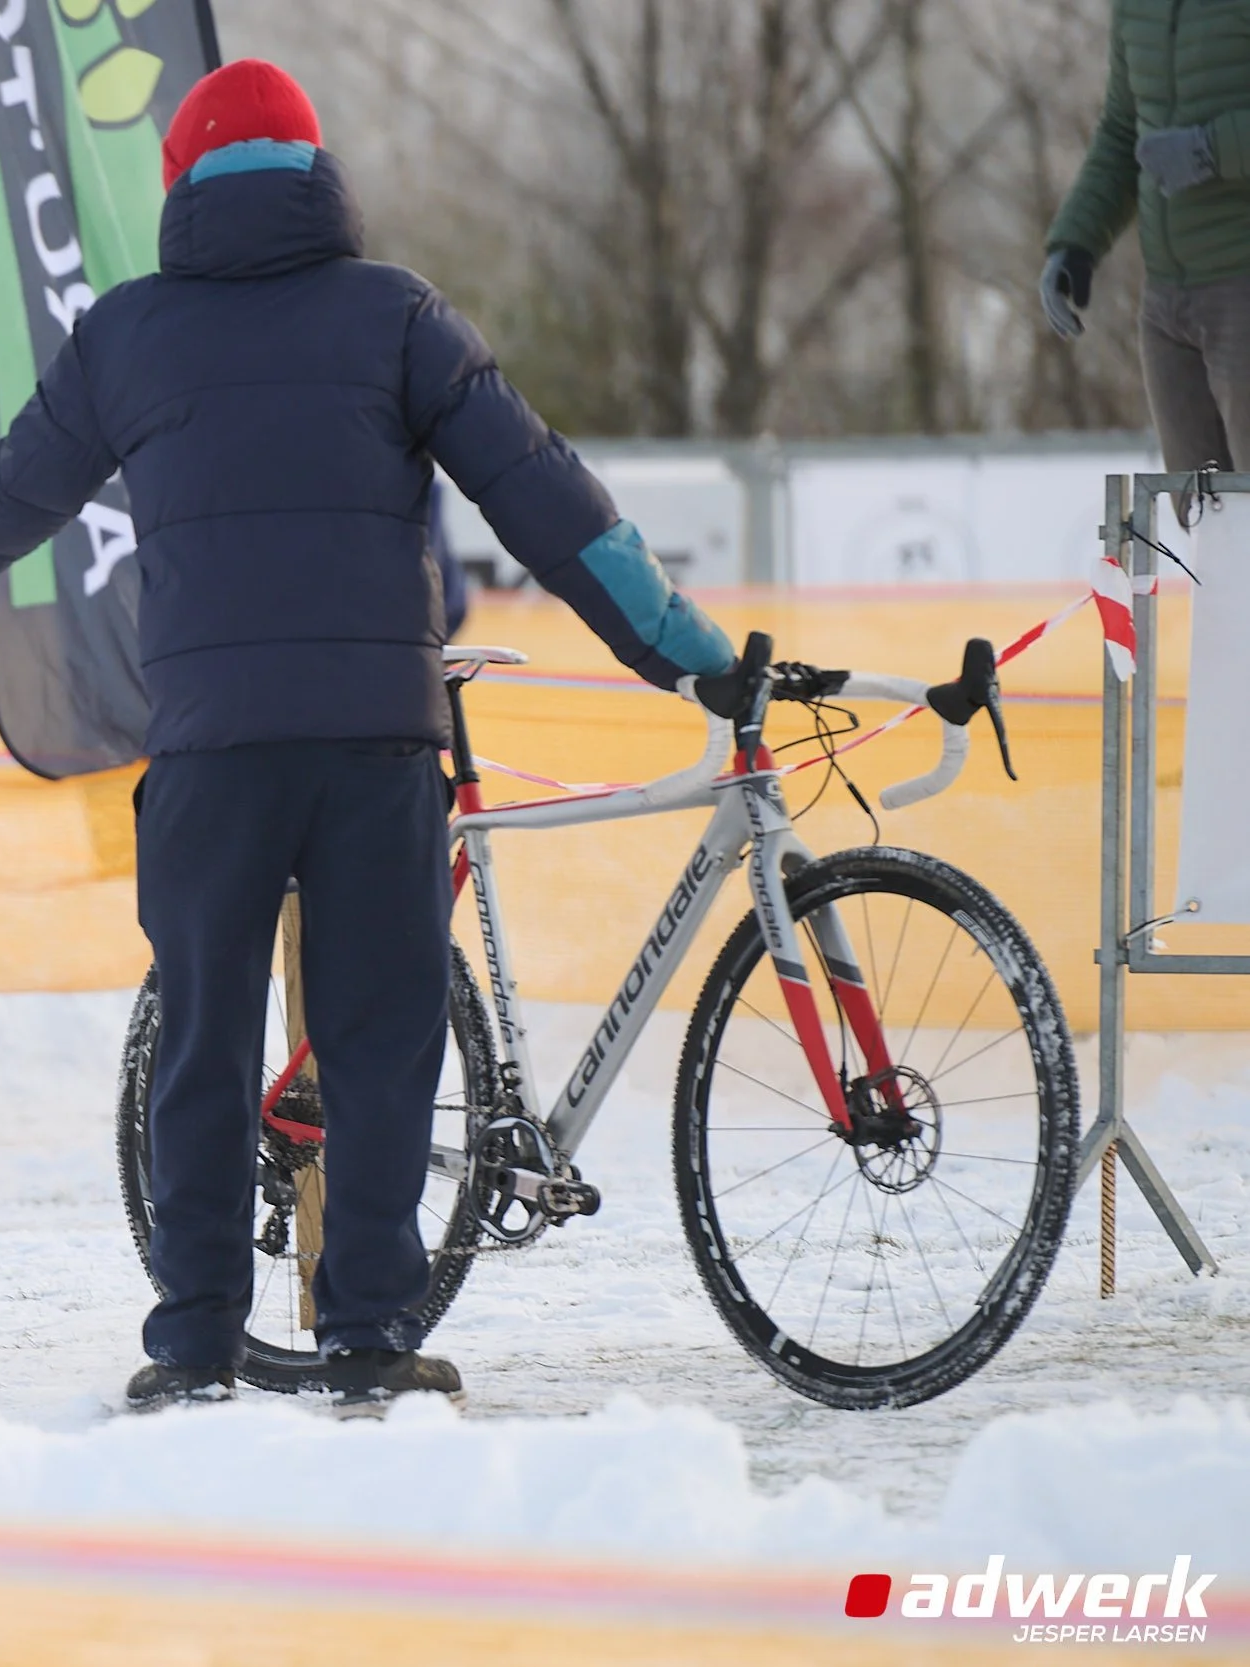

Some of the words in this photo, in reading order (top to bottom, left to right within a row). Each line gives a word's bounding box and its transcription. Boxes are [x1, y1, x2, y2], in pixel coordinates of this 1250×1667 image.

[470, 861, 515, 1044] cannondale
[742, 783, 783, 948] cannondale
[566, 844, 711, 1109] cannondale
